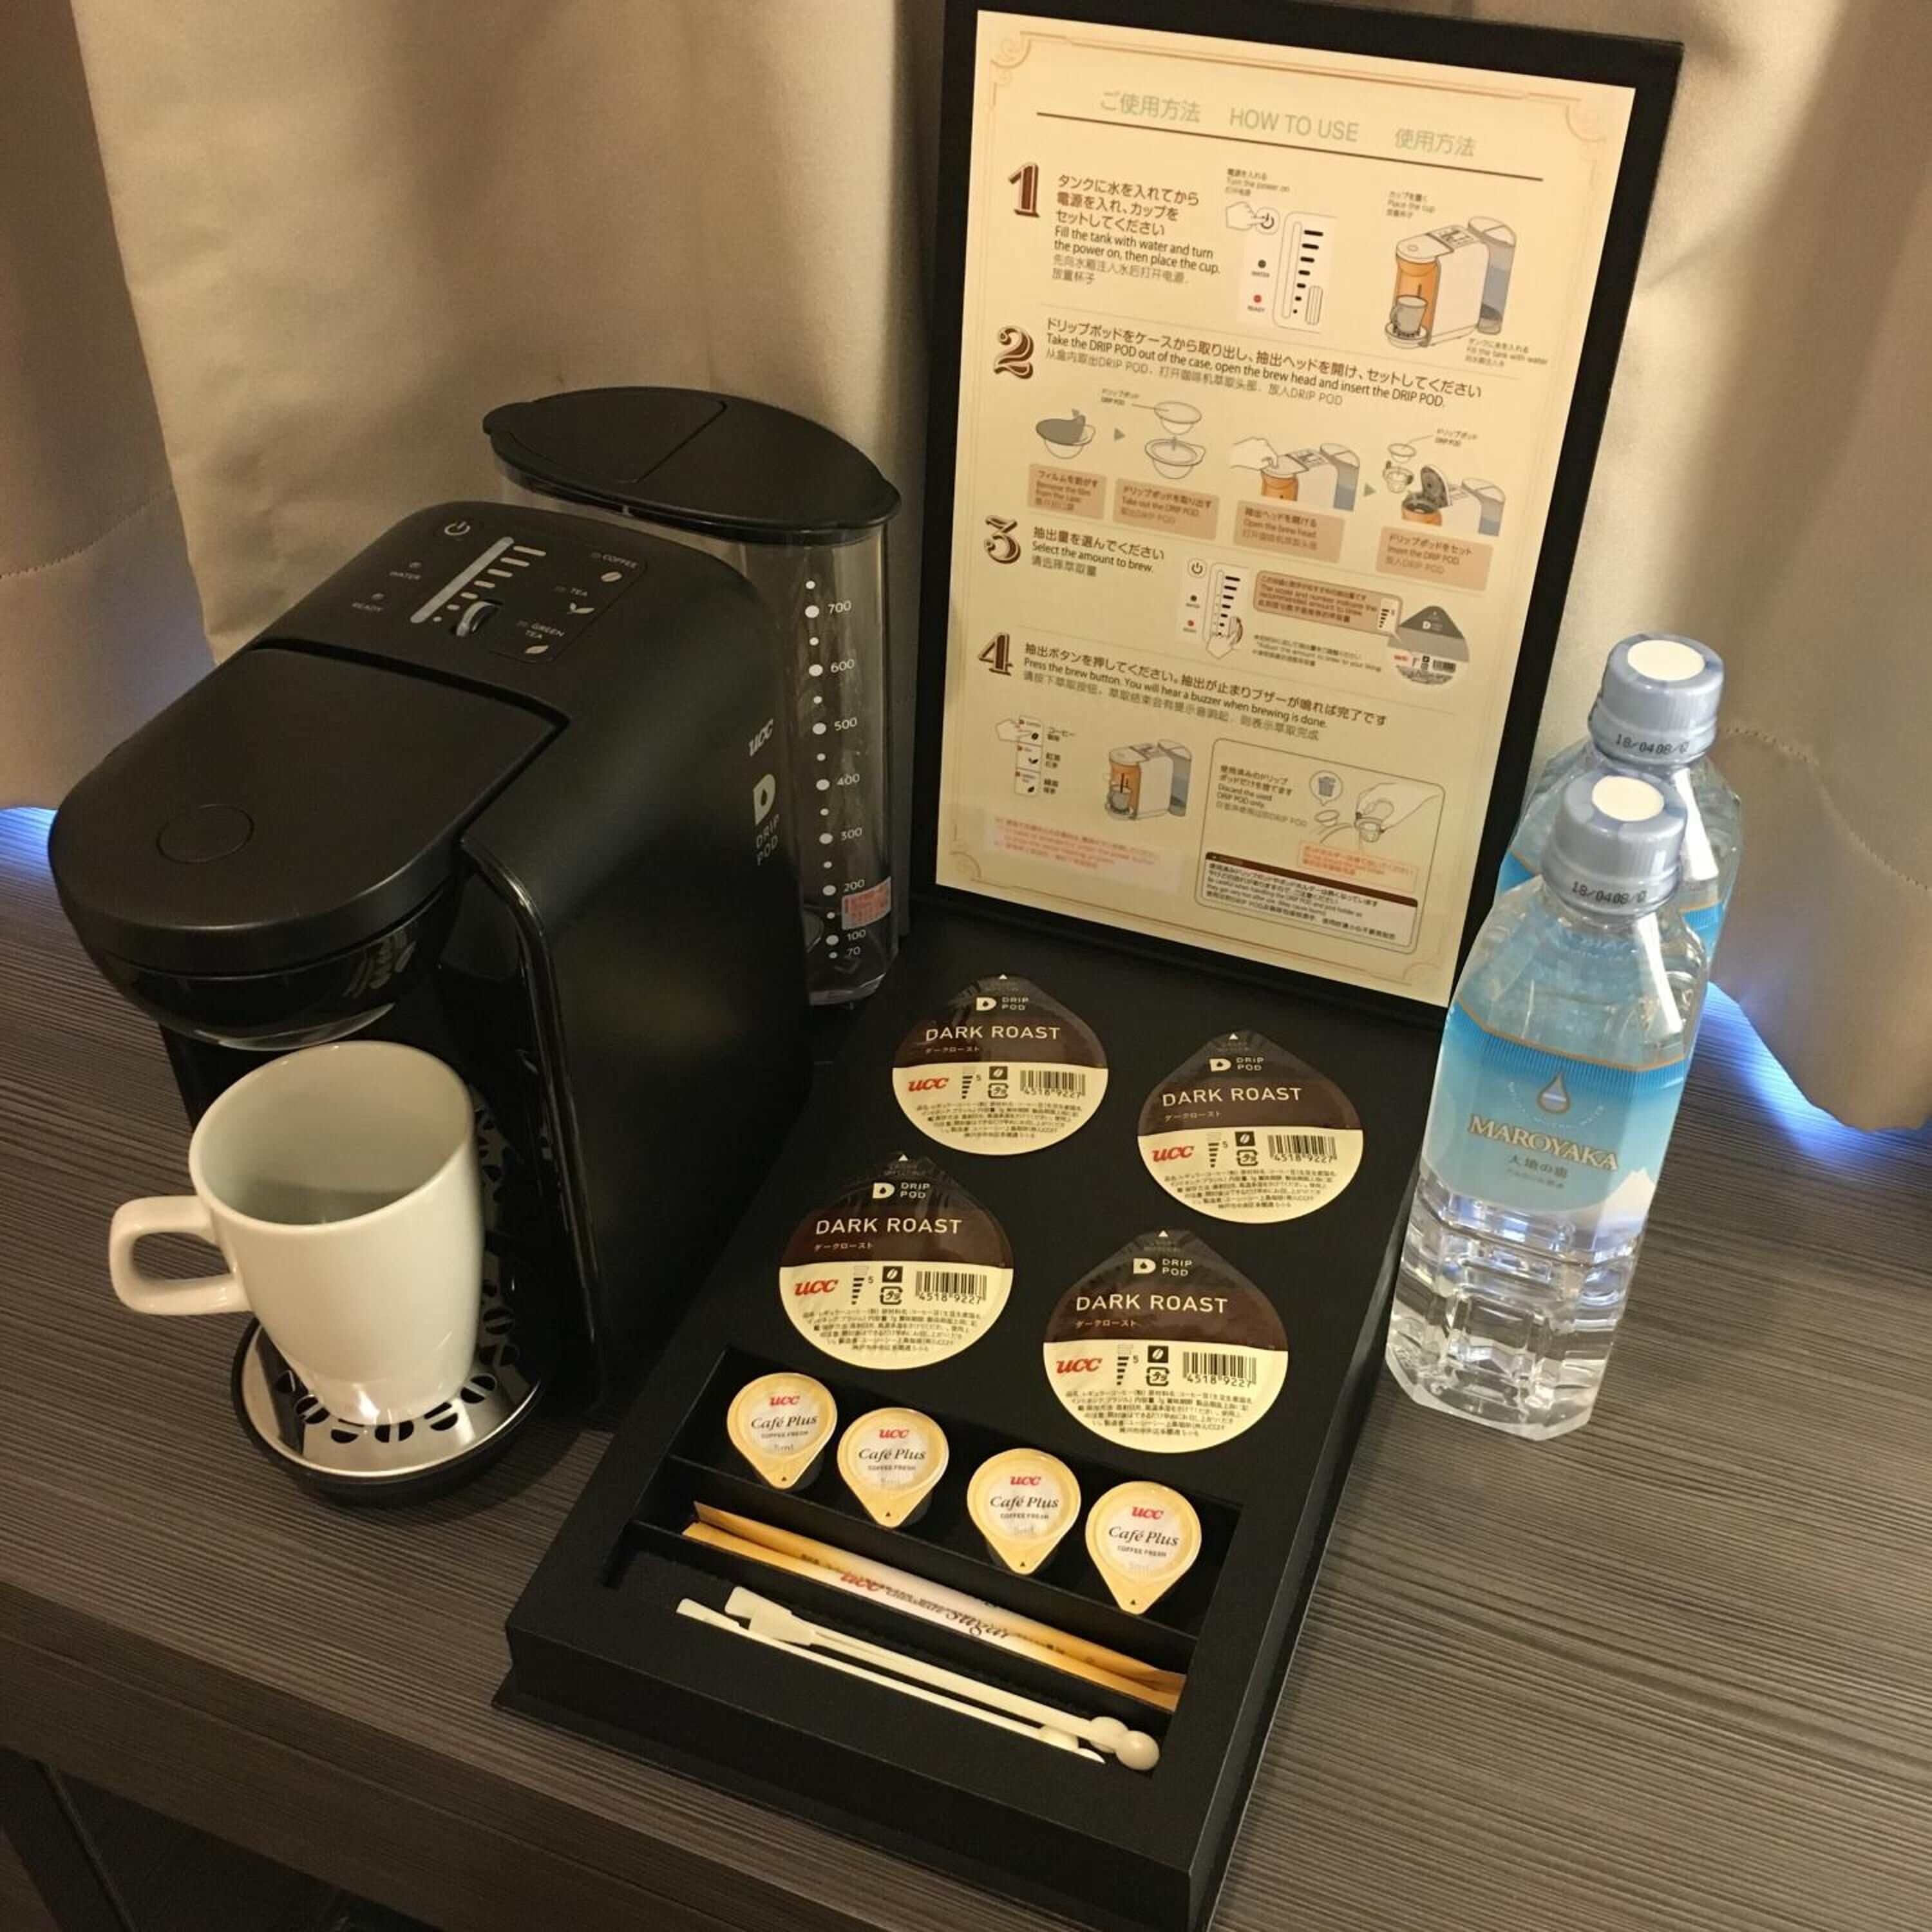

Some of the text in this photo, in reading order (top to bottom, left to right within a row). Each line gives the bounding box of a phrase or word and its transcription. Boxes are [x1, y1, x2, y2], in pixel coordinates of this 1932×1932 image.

[1100, 89, 1201, 123] ご使用方法
[1229, 106, 1359, 142] HOW TO USE
[1394, 127, 1477, 158] 使用方法
[1009, 159, 1043, 218] 1
[1058, 173, 1200, 207] タンクに水を入れてから
[1057, 191, 1179, 222] 電源を入れ、カップを
[1056, 209, 1165, 237] セットしてください
[1055, 225, 1213, 259] Fill the tank with water and turn
[1054, 239, 1221, 276] the power on, then place the cup.
[992, 324, 1036, 380] 2
[1047, 332, 1446, 406] Take the DRIP POD out of the case, open the brew head and insert the DRIP POD.
[982, 513, 1023, 567] 3
[1034, 526, 1164, 562] 抽出量を選んでください
[601, 554, 638, 569] COFFEE
[1032, 540, 1153, 573] Select the amount to brew.
[569, 587, 588, 597] TEA
[828, 600, 852, 614] 700
[526, 629, 543, 639] TEA
[530, 623, 566, 637] GREEN
[977, 627, 1014, 676] 4
[831, 659, 855, 673] 600
[1025, 658, 1046, 670] Press
[1048, 663, 1063, 674] the
[1065, 666, 1086, 679] brew
[1126, 678, 1141, 690] You
[1144, 682, 1159, 694] will
[1161, 686, 1181, 698] hear
[1191, 692, 1221, 706] buzzer
[1223, 699, 1249, 712] when
[1250, 704, 1289, 722] brewing
[1291, 713, 1299, 723] is
[1300, 714, 1328, 728] done.
[834, 717, 858, 732] 500
[837, 773, 860, 786] 400
[841, 828, 863, 840] 300
[844, 878, 865, 893] 200
[847, 929, 866, 942] 100
[848, 945, 861, 956] 70
[925, 1026, 1060, 1041] DARK ROAST
[907, 1077, 949, 1092] ucc
[1162, 1087, 1303, 1107] DARK ROAST
[1468, 1112, 1619, 1171] MAROYAKA
[1151, 1146, 1195, 1162] ucc
[816, 1218, 962, 1235] DARK ROAST
[1162, 1258, 1193, 1267] DRIP
[1162, 1267, 1188, 1276] POD
[793, 1279, 838, 1296] ucc
[918, 1291, 982, 1305] 4518 9227
[1076, 1294, 1228, 1314] DARK ROAST
[1075, 1319, 1136, 1329] ダークロースト
[1056, 1358, 1103, 1374] ucc
[1186, 1373, 1252, 1388] 4518 9227
[770, 1396, 800, 1406] ucc
[751, 1415, 817, 1430] Café Plus
[879, 1429, 909, 1439] ucc
[858, 1449, 926, 1461] Café Plus
[1010, 1475, 1041, 1486] ucc
[990, 1495, 1059, 1508] Café Plus
[1132, 1506, 1164, 1520] ucc
[1108, 1525, 1180, 1547] Café Plus
